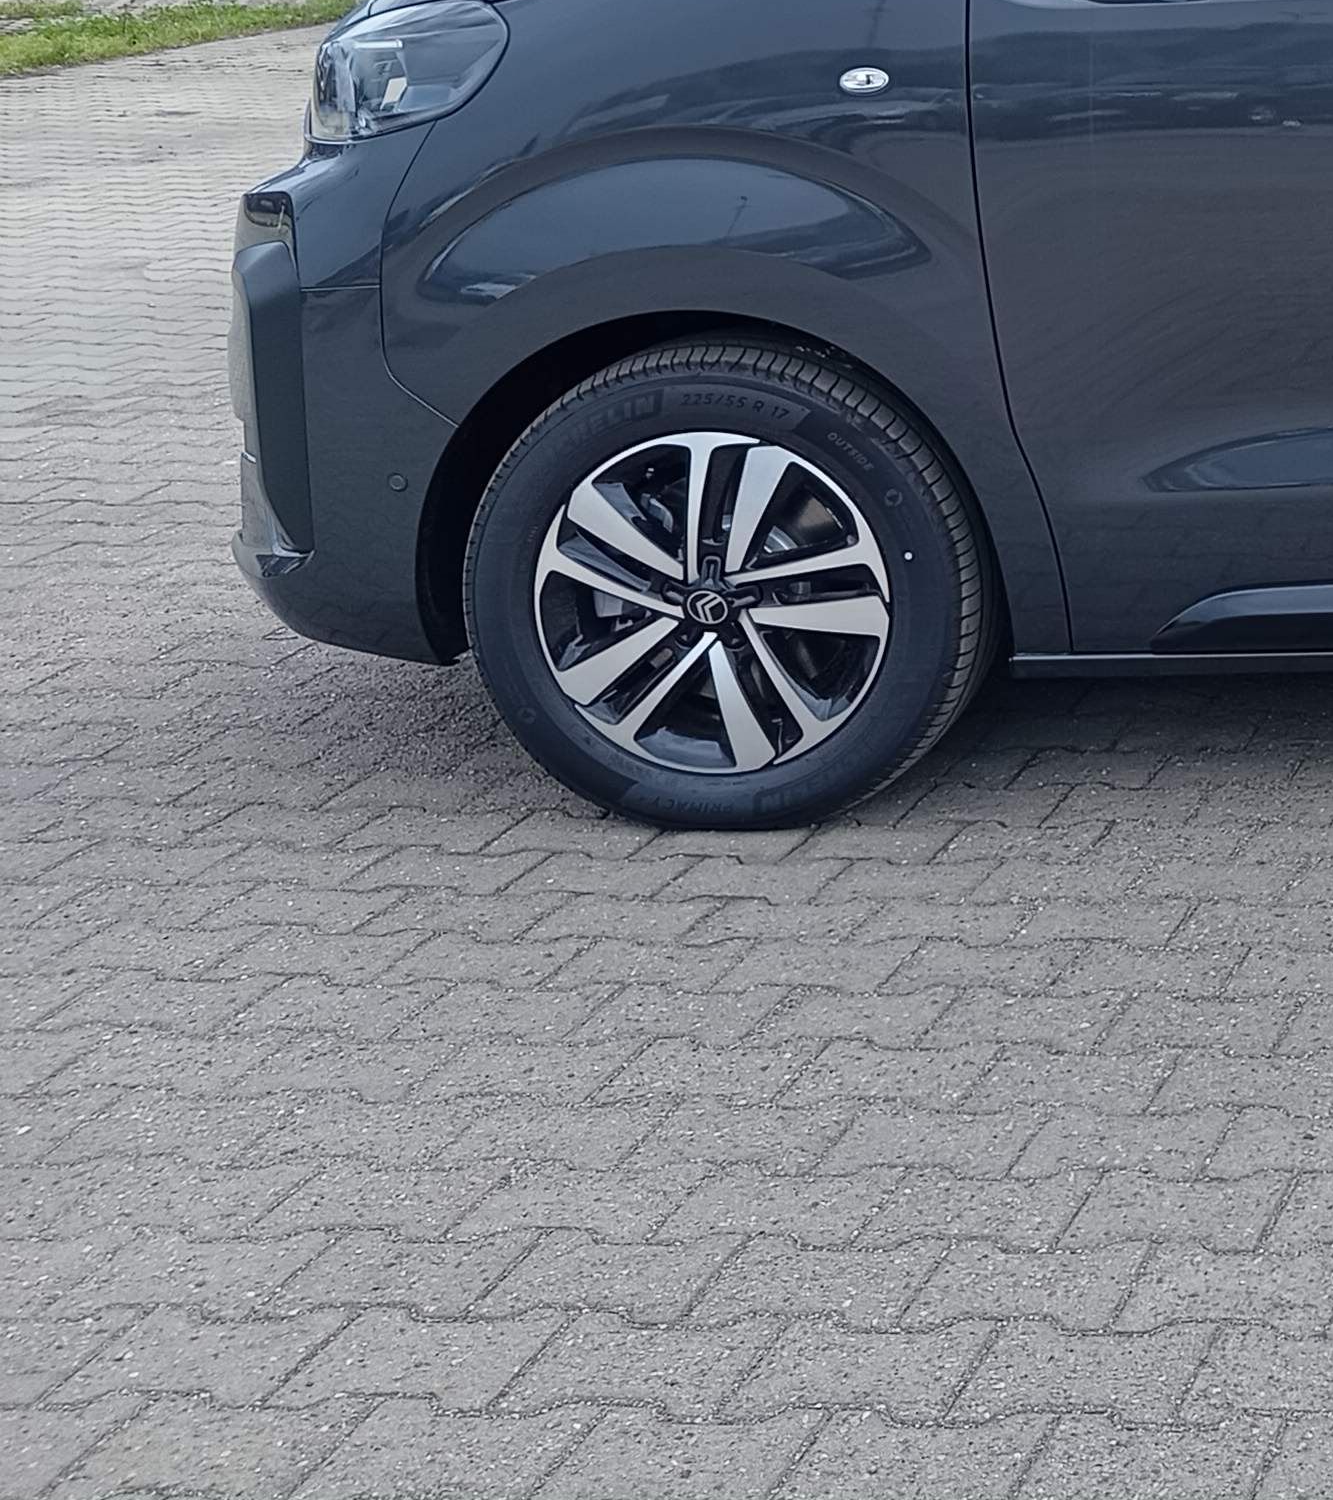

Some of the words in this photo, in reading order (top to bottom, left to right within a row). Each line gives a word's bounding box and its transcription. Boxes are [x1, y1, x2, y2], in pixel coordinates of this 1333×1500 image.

[679, 392, 746, 409] 225/55
[751, 400, 764, 413] R
[770, 405, 790, 420] 17
[826, 431, 875, 472] OUTSIDE
